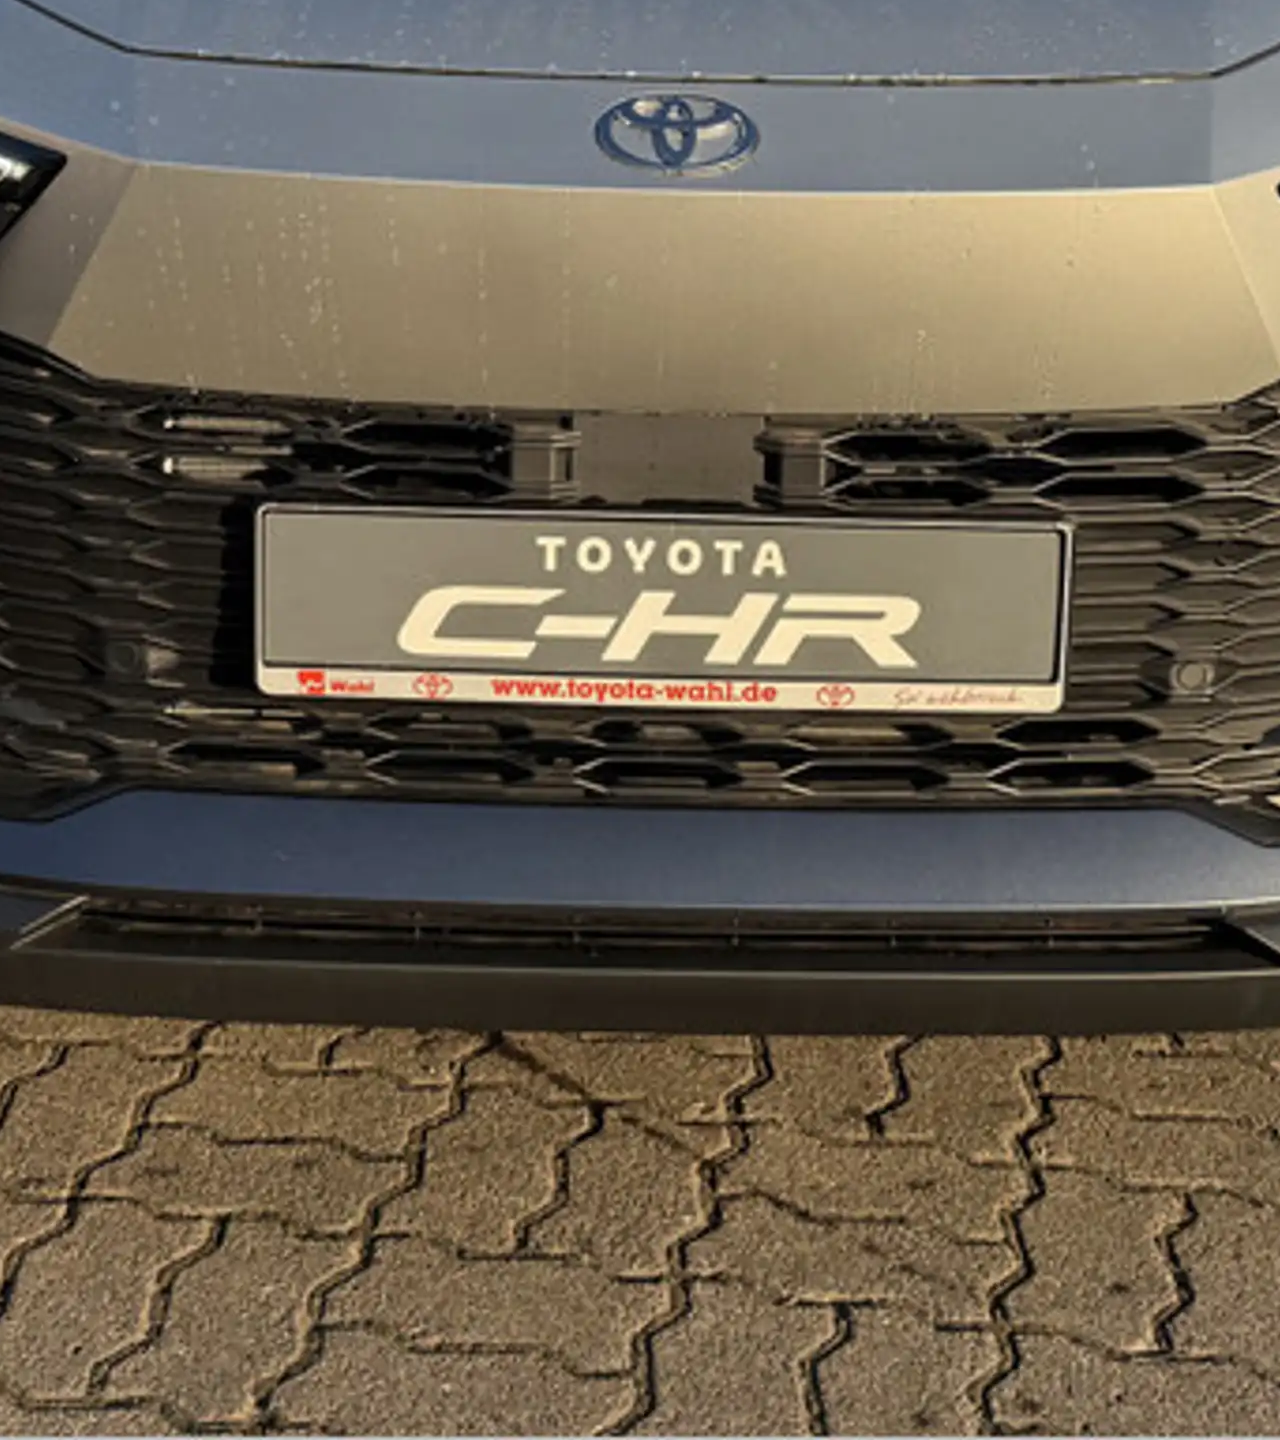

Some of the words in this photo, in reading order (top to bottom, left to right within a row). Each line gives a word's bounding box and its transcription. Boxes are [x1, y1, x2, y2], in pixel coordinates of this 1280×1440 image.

[535, 535, 788, 577] TOYOTA
[395, 584, 922, 669] C-HR
[490, 677, 779, 704] www.toyota-wahl.de
